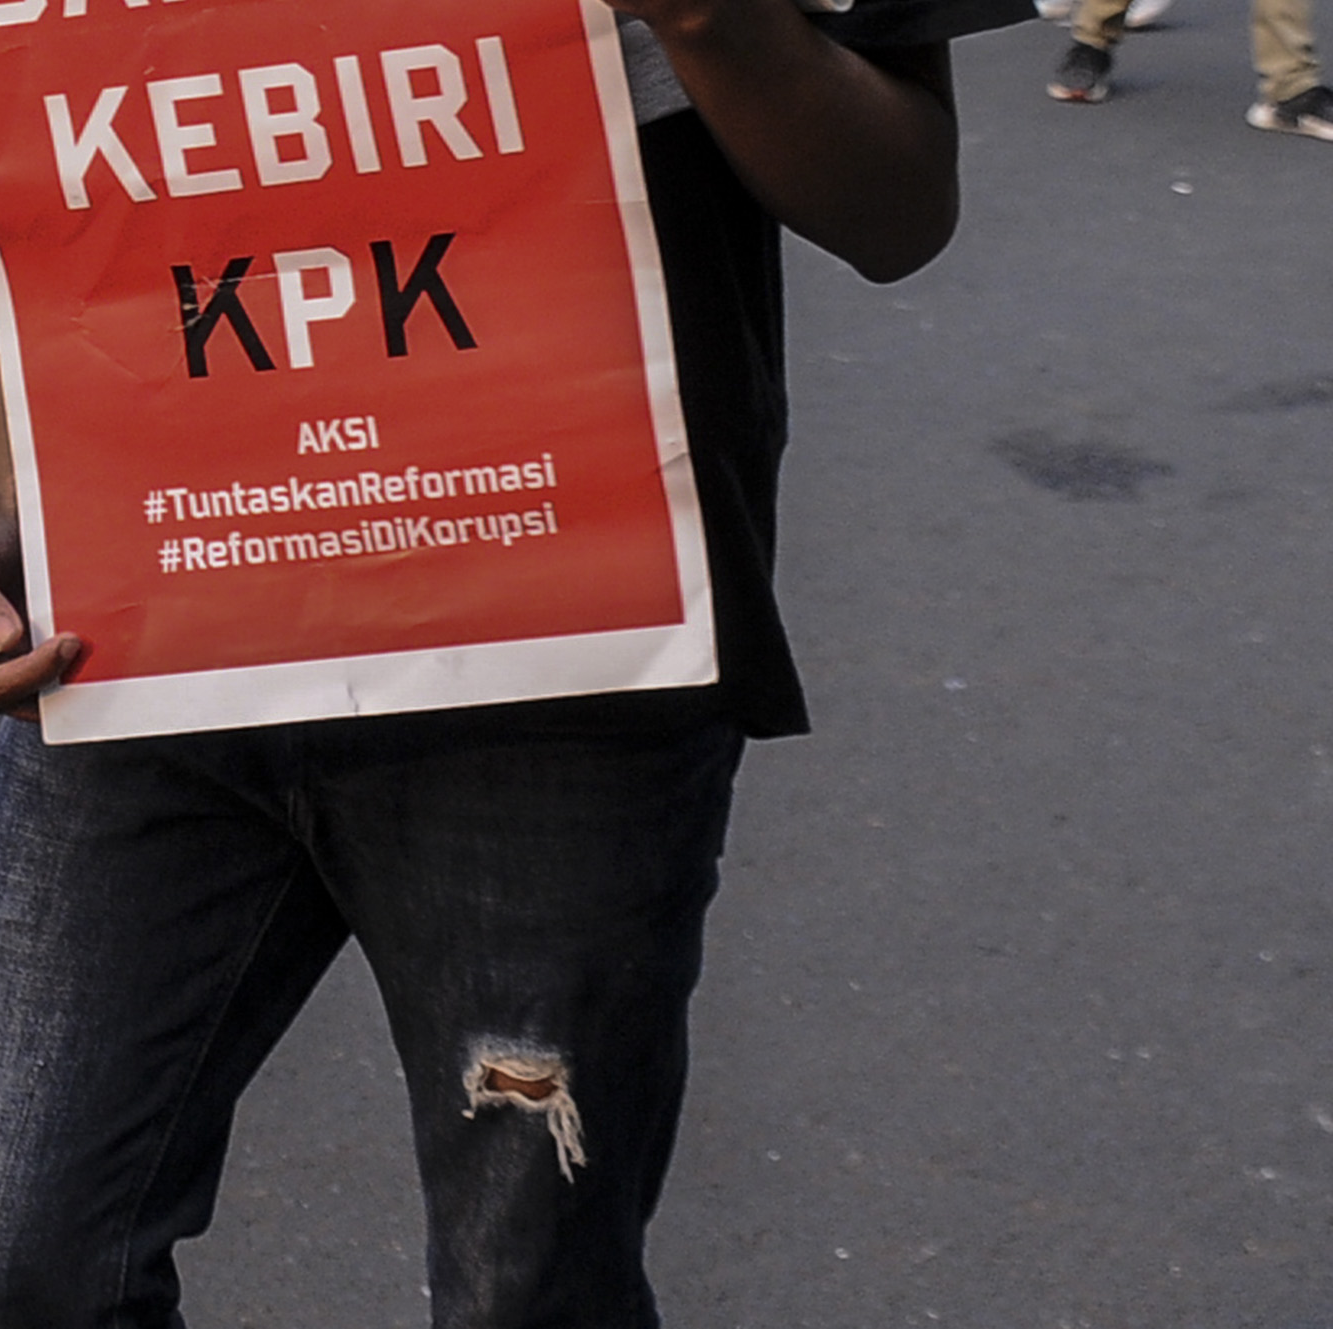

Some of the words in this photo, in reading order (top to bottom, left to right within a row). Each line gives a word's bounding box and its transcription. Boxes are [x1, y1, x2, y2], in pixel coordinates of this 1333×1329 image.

[43, 36, 525, 210] KEBIRI
[170, 232, 478, 378] KPK
[297, 415, 380, 455] AKSI
[143, 452, 558, 524] #TuntaskanReformasi
[157, 502, 559, 574] #ReformasiDiKorupsi
